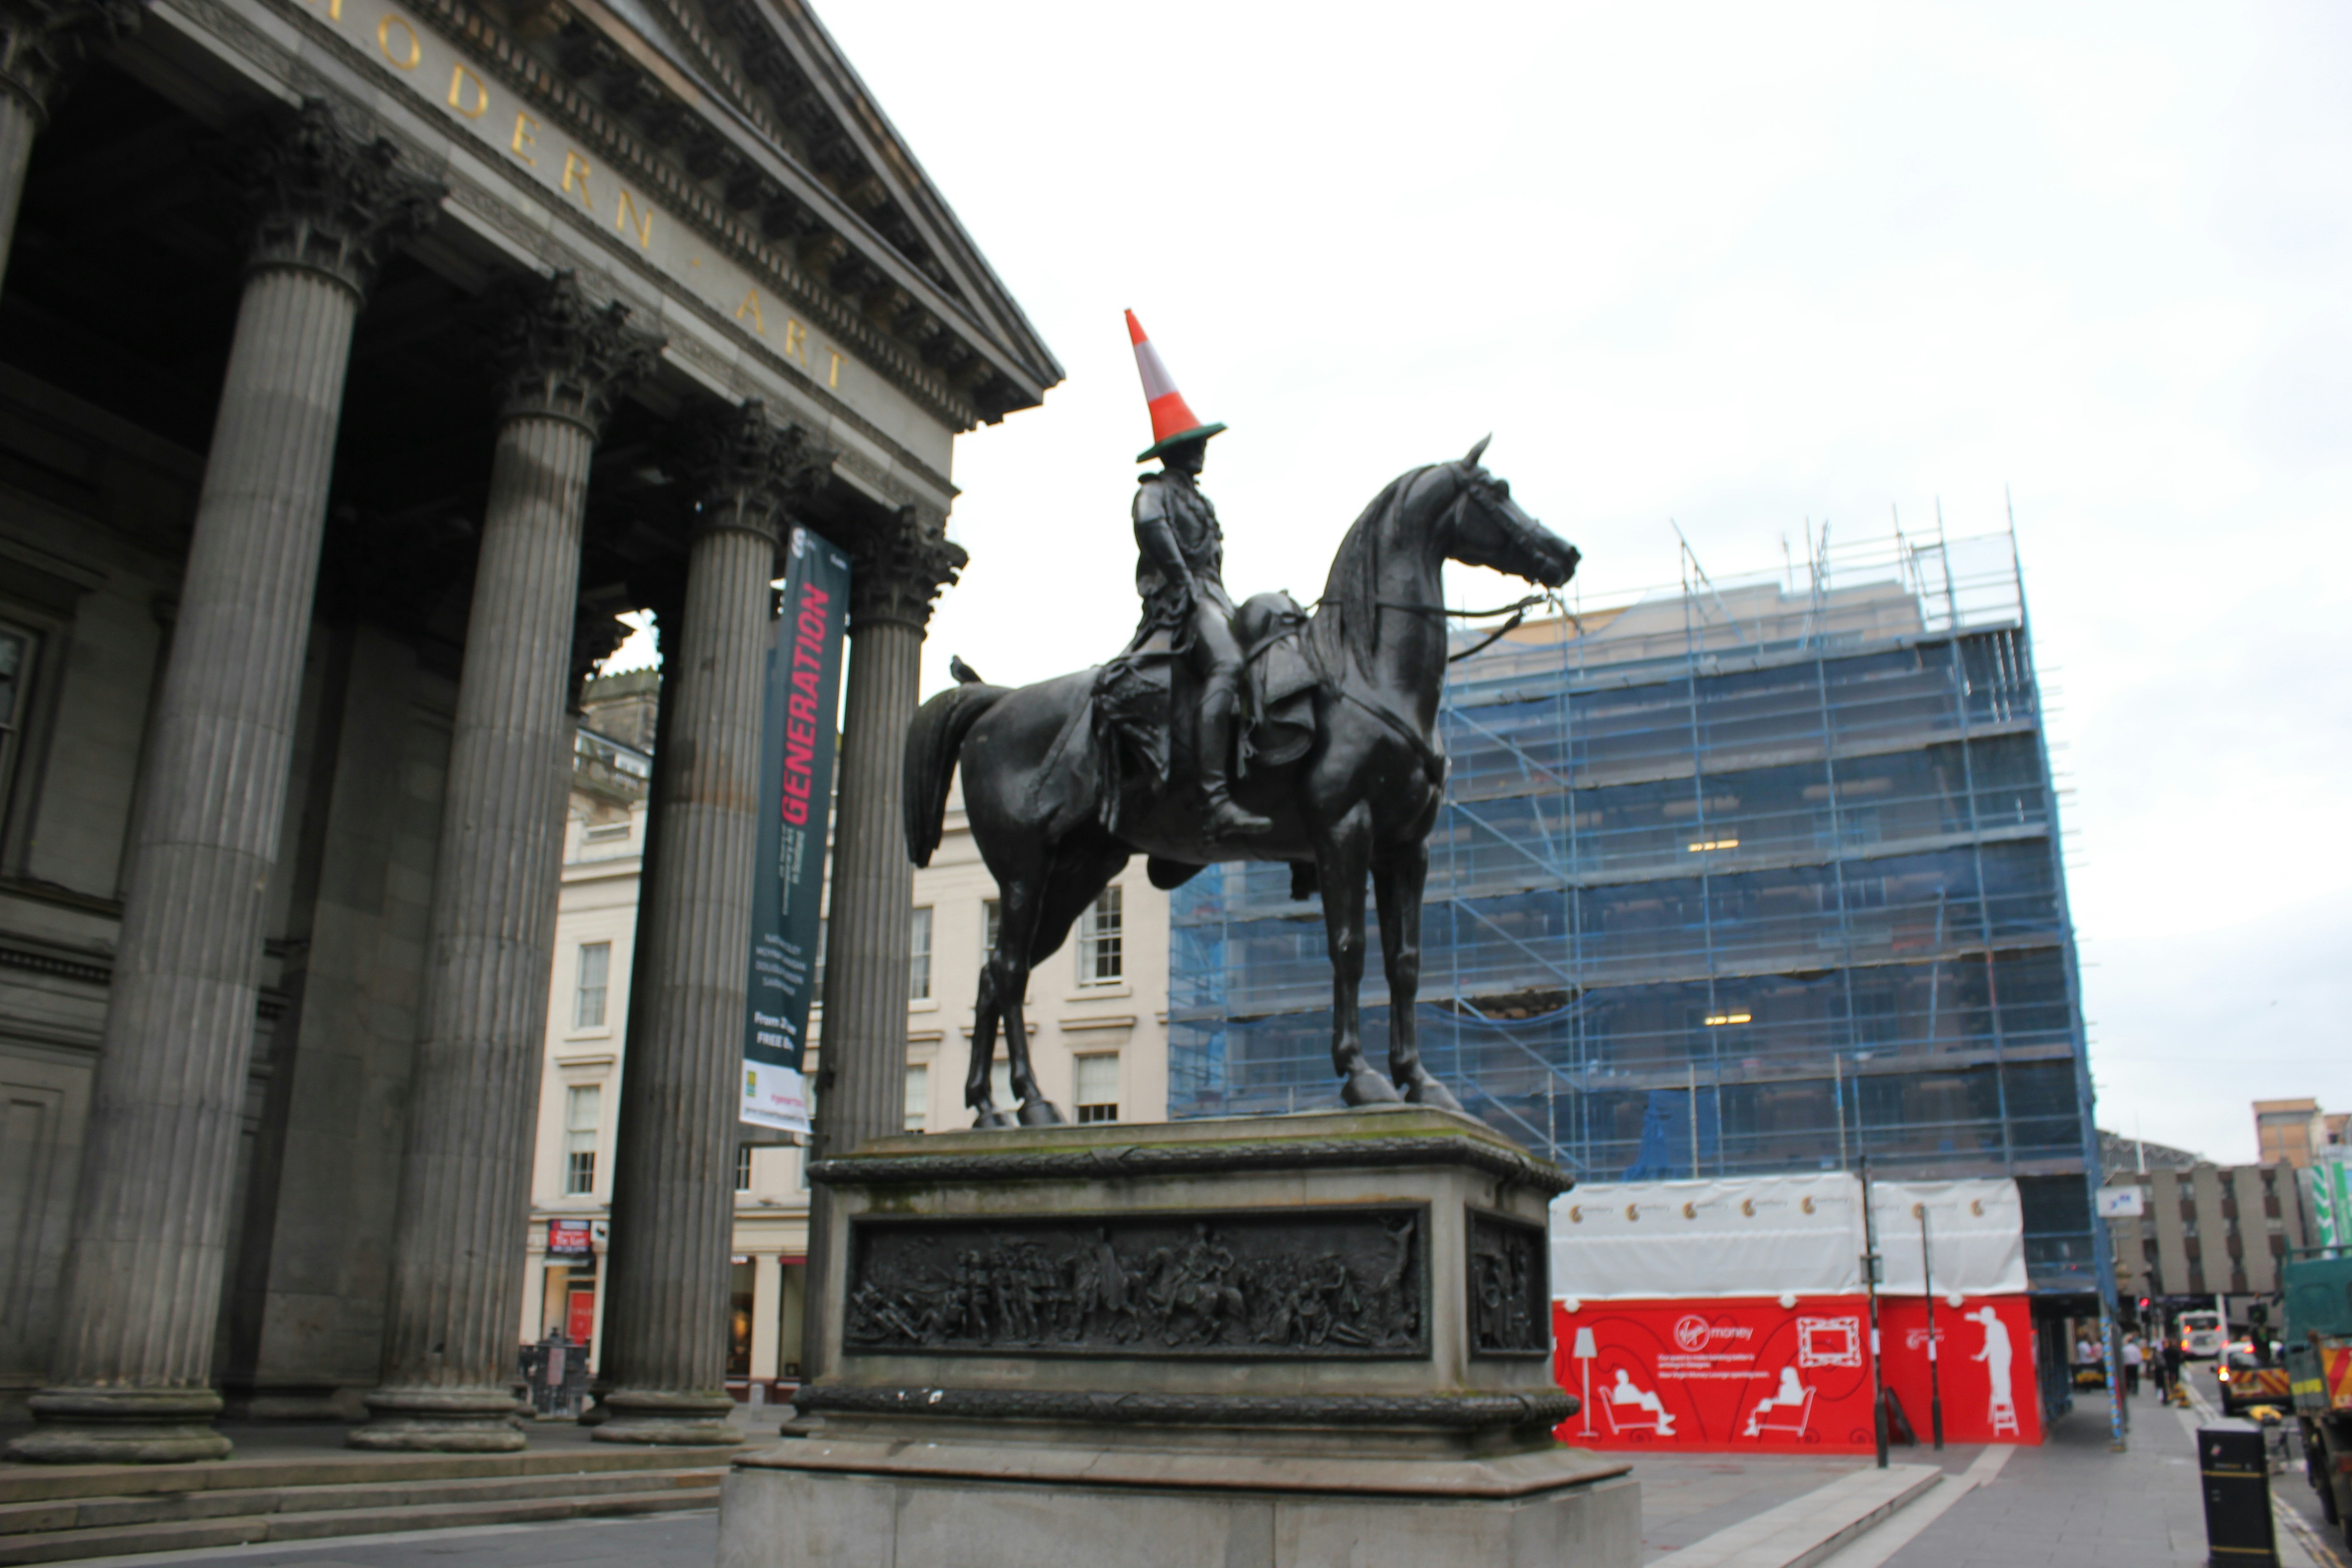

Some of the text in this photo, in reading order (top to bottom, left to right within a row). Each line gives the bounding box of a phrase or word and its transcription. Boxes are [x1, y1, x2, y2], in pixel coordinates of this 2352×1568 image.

[307, 0, 848, 387] ODERN ART
[781, 583, 829, 825] GENERATION
[1710, 1327, 1754, 1341] money
